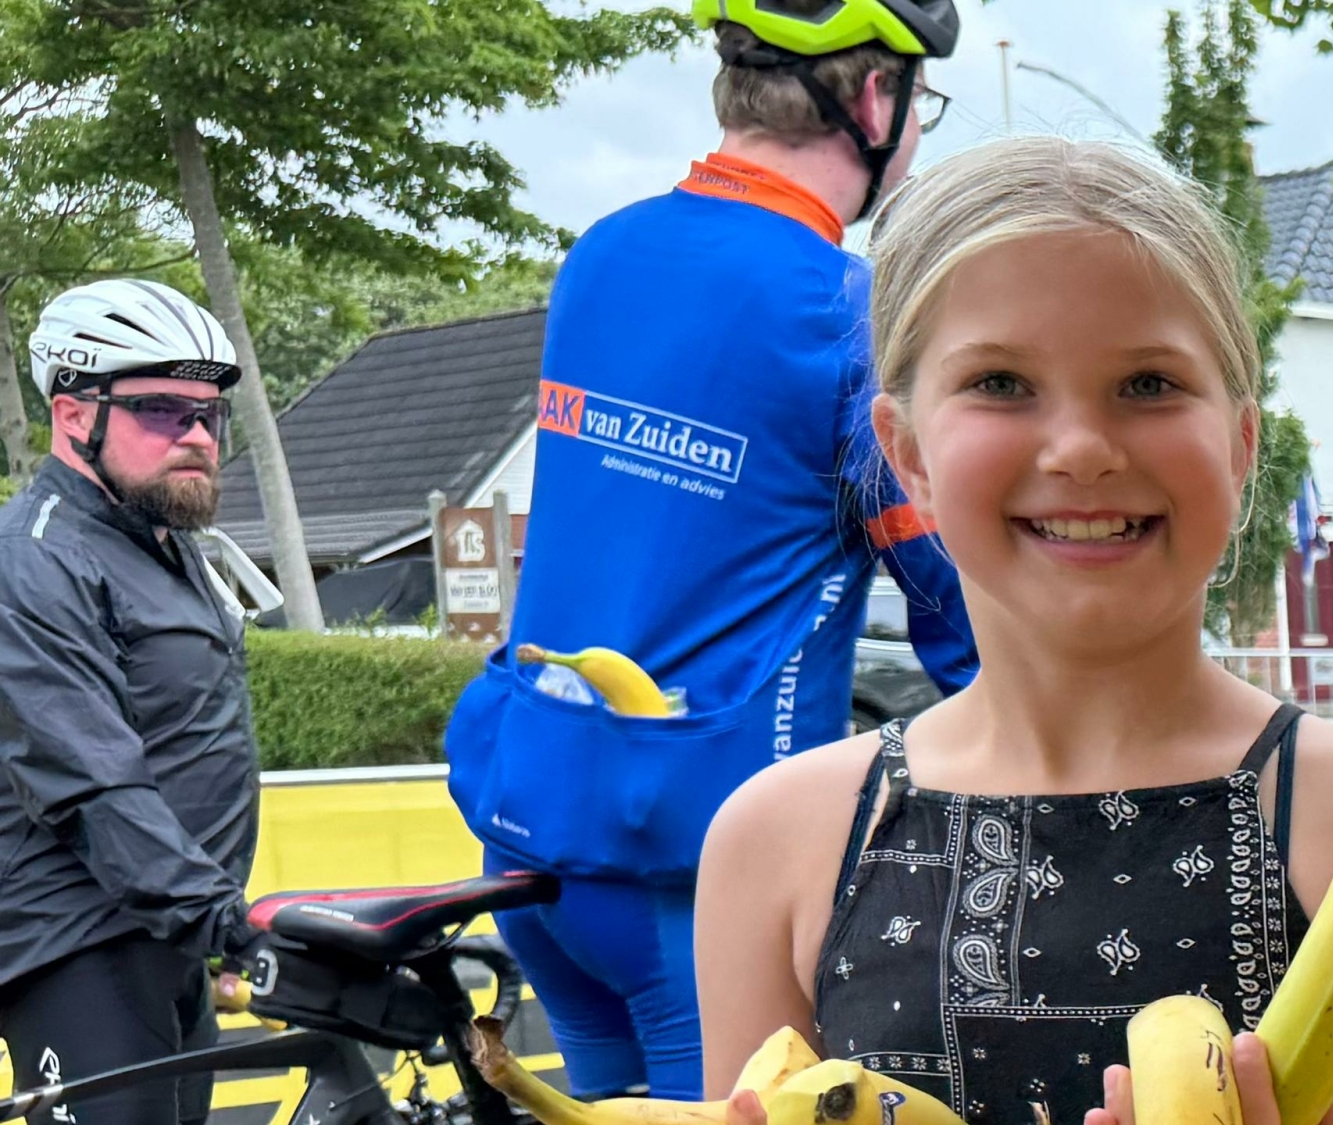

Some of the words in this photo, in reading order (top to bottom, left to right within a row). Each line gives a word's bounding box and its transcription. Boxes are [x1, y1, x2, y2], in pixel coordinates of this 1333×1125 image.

[586, 409, 622, 440] van
[623, 411, 733, 474] Zuiden
[600, 453, 662, 482] Administratie
[661, 472, 678, 487] en
[679, 474, 726, 501] advies
